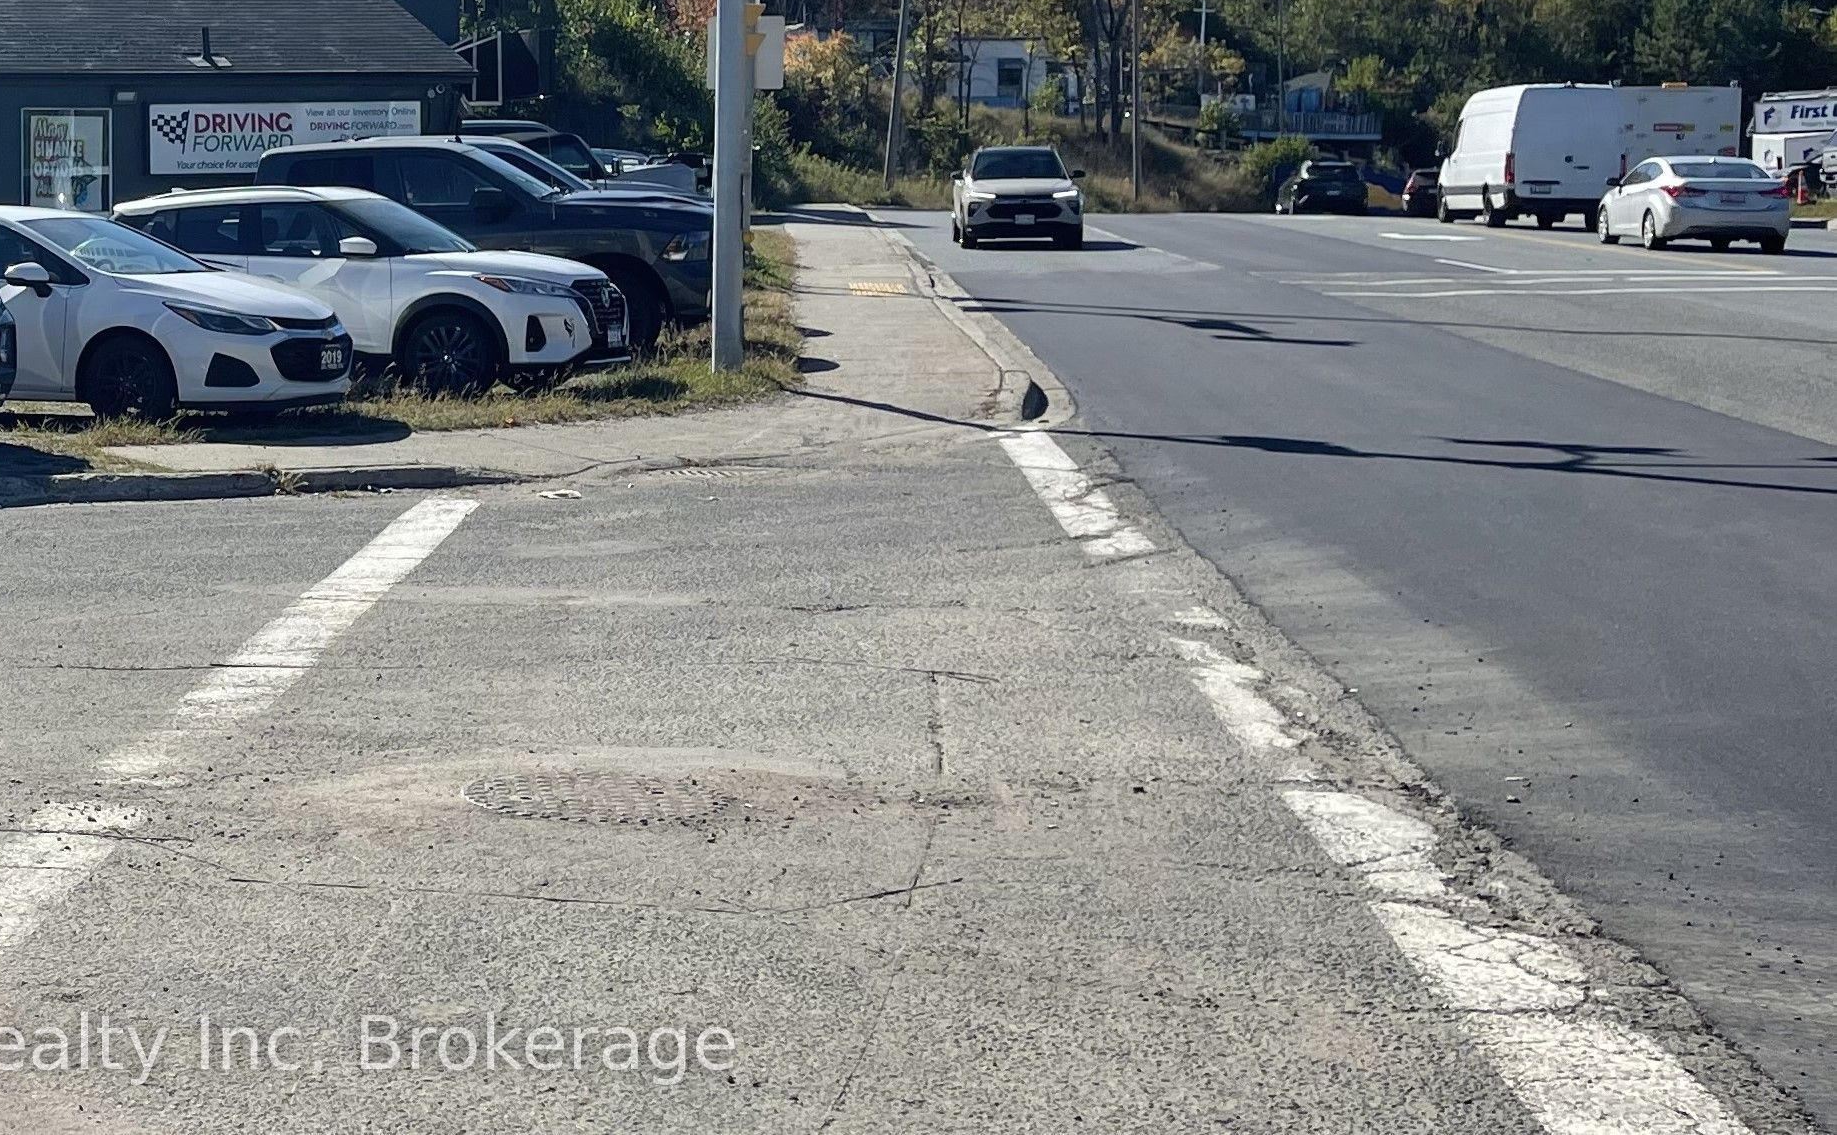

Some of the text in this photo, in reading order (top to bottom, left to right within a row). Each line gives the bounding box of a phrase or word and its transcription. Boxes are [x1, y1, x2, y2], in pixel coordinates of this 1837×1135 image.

[1790, 104, 1828, 119] First
[194, 112, 293, 134] DRIVING
[192, 134, 294, 152] FORWARD
[176, 160, 259, 170] Your choice for used
[321, 350, 342, 364] 2019
